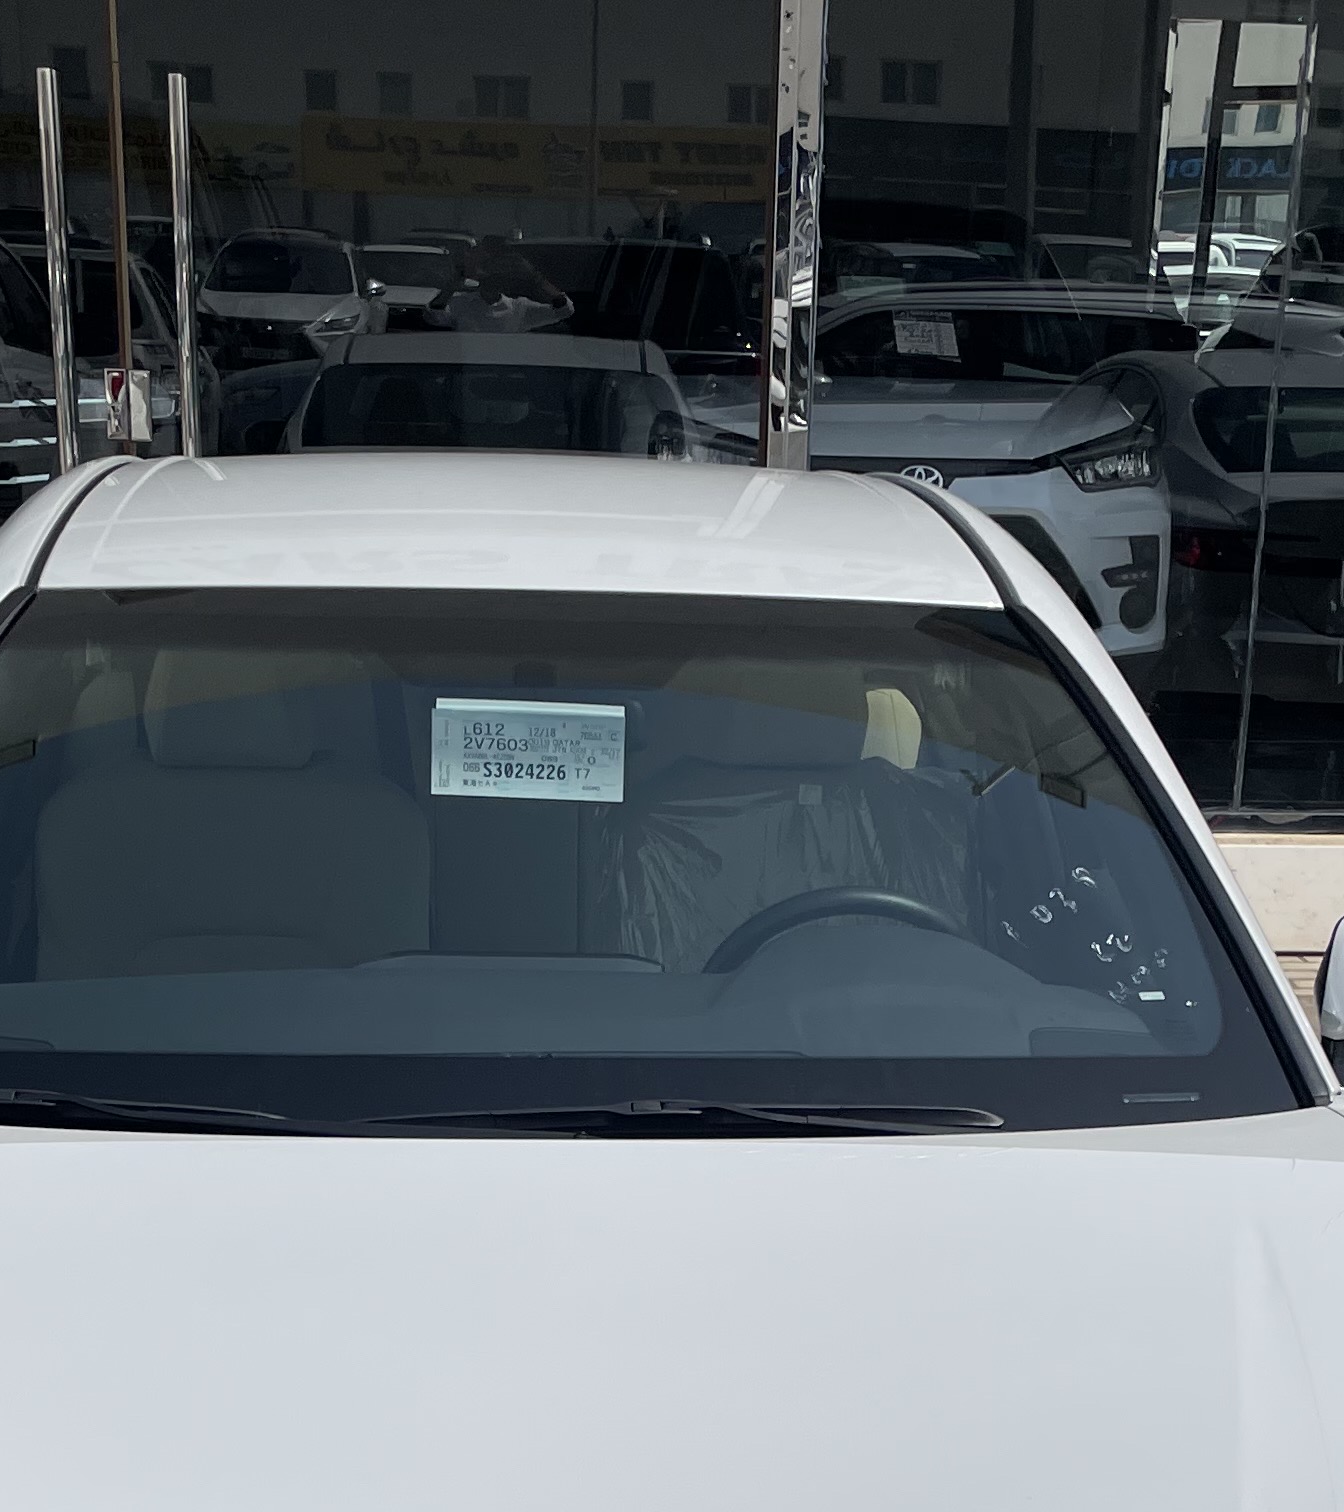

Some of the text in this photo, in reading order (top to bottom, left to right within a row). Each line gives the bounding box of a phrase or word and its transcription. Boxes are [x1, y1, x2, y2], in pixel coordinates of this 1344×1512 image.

[463, 721, 505, 737] L612
[529, 727, 557, 738] 12/18
[463, 736, 529, 752] 2V7603
[483, 761, 567, 781] S3024226
